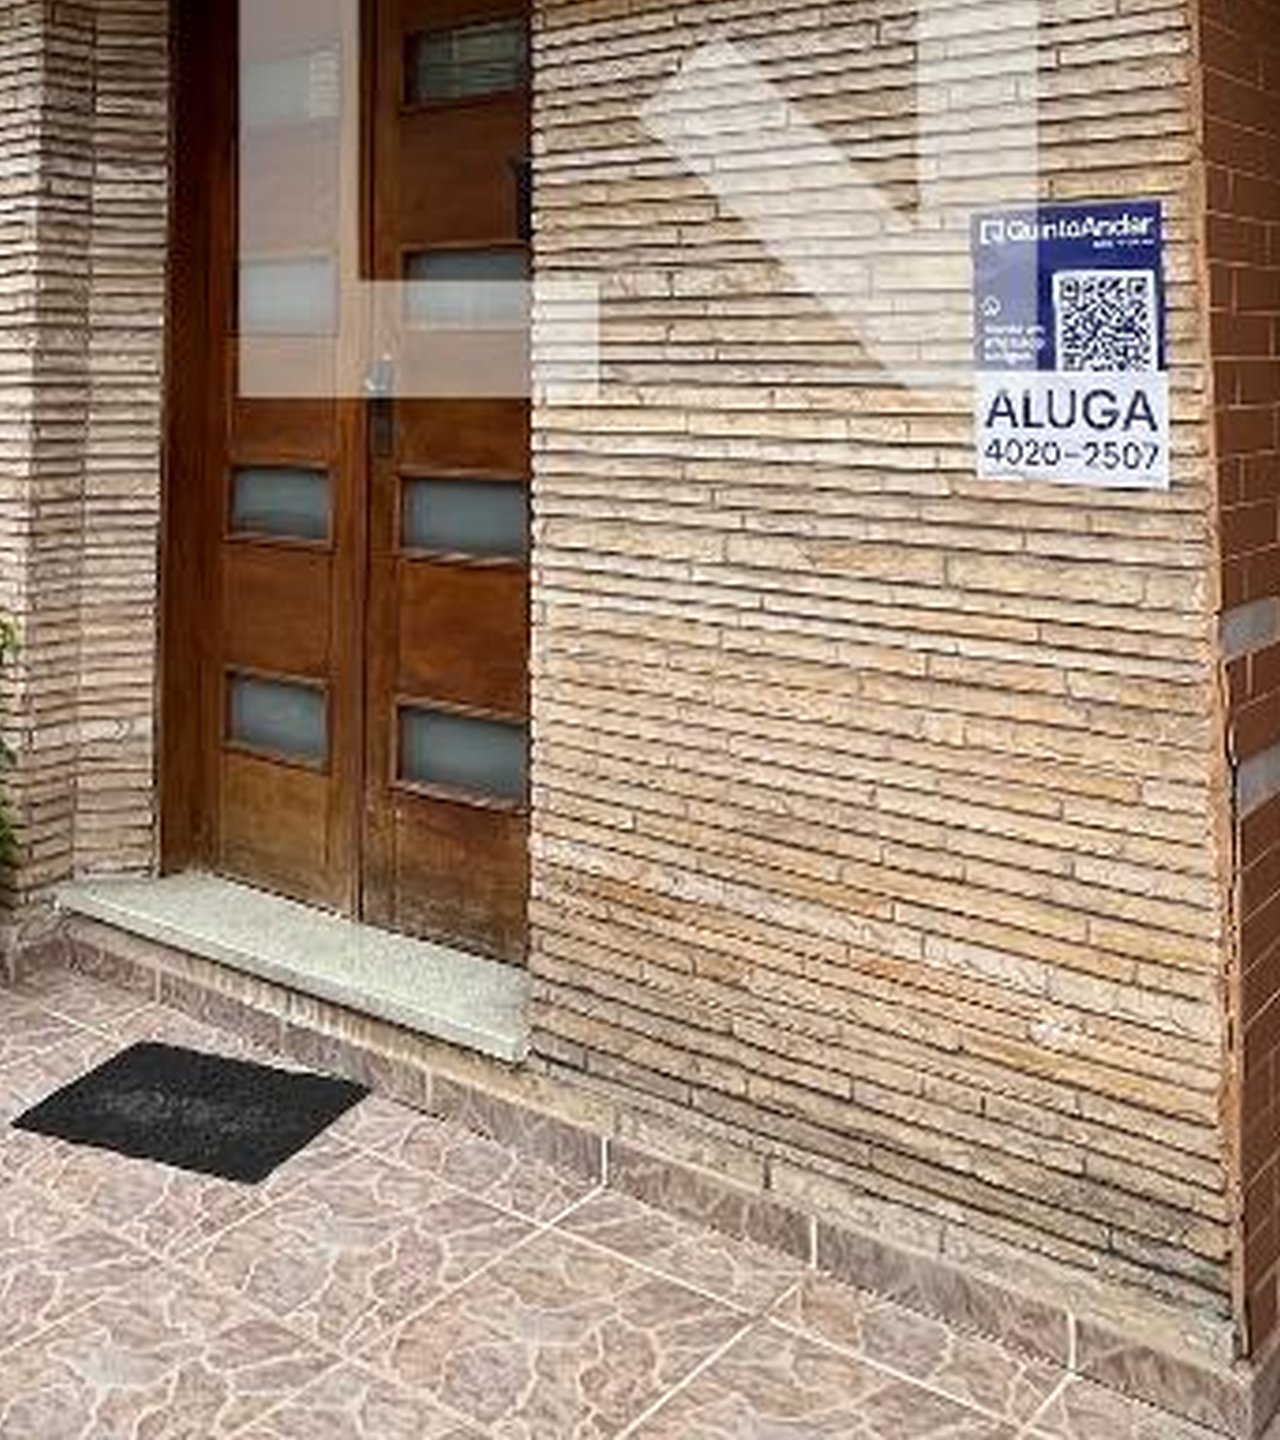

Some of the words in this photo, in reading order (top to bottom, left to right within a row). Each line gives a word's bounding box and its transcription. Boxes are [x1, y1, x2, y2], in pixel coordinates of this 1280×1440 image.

[1006, 213, 1154, 241] QuntoAndar
[985, 389, 1158, 431] ALUGA
[984, 438, 1160, 470] 4020-2507
